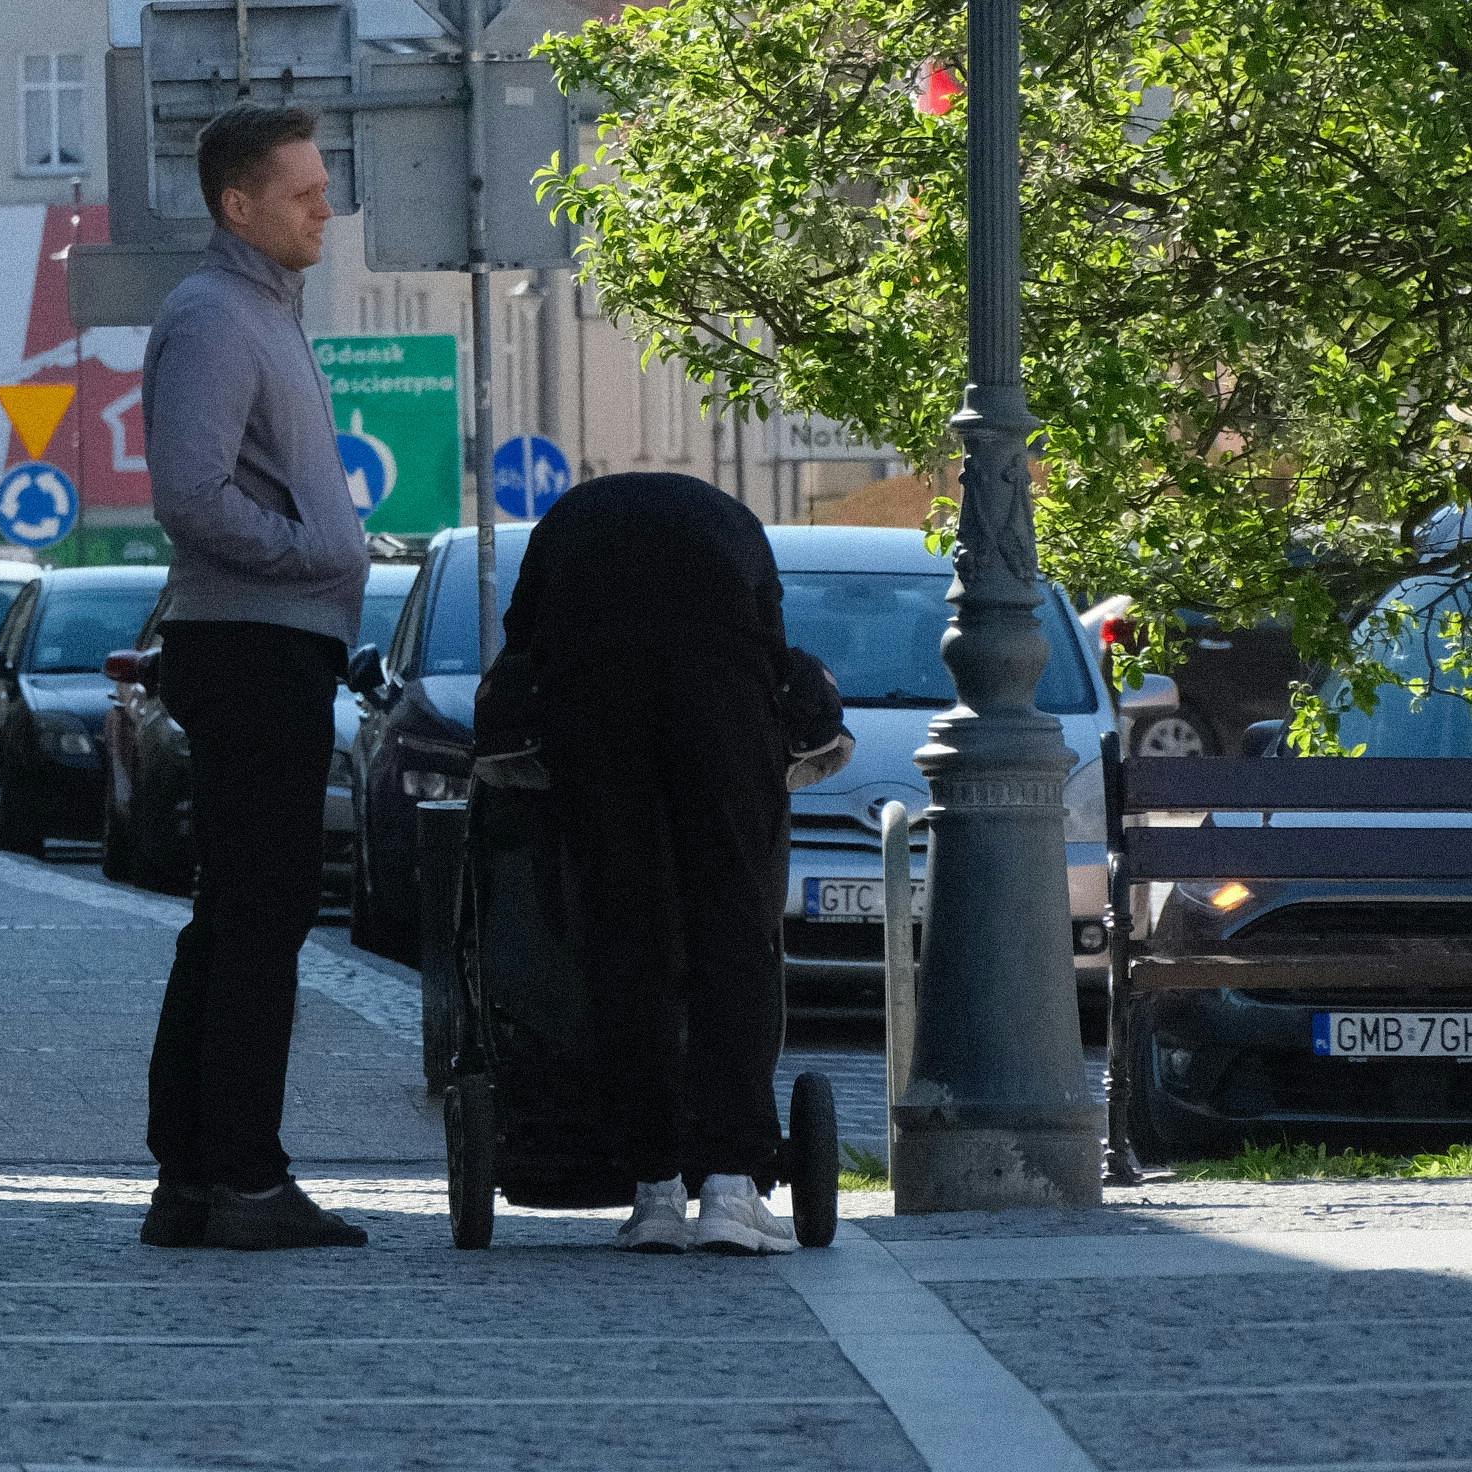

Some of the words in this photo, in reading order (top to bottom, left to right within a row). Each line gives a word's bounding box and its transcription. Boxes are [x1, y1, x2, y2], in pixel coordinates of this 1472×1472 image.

[316, 343, 404, 366] Gdańsk
[327, 373, 455, 397] ościerzyna
[822, 884, 873, 912] GTC
[1336, 1017, 1404, 1053] GMB
